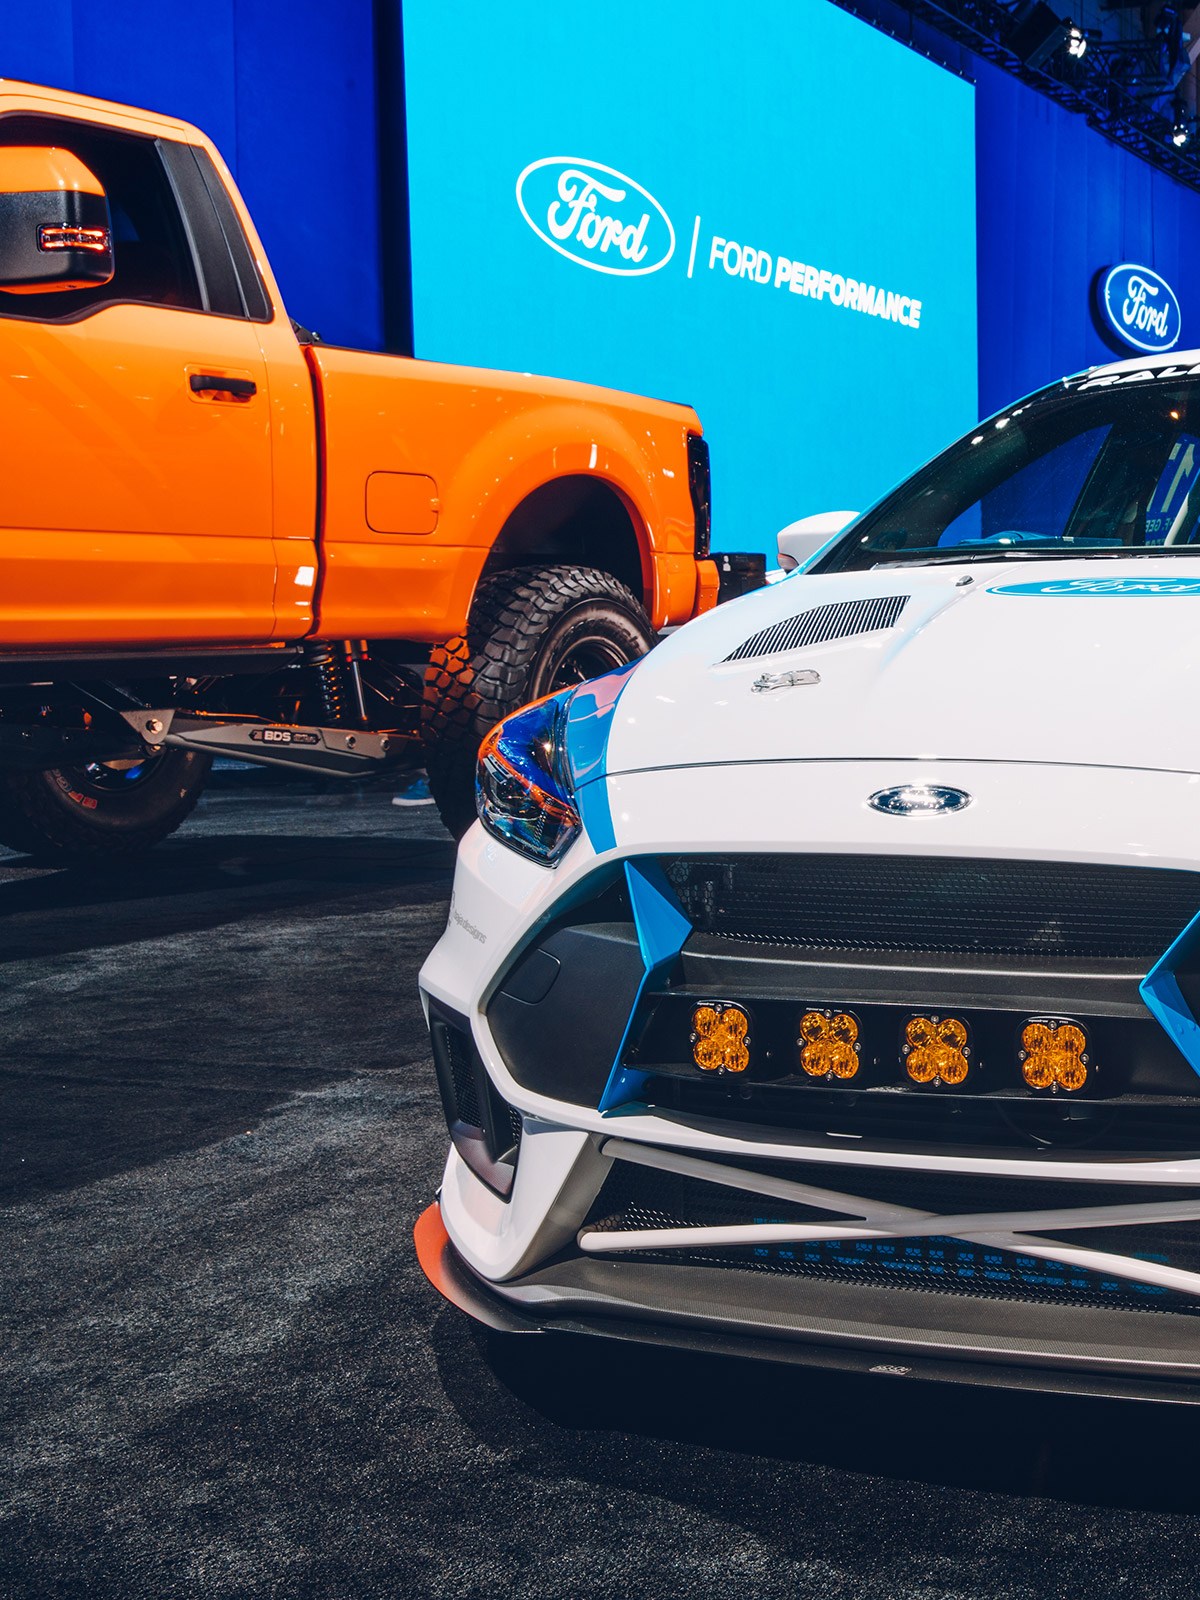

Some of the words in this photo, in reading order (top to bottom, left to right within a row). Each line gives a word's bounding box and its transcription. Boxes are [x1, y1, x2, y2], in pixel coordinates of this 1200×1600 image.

[547, 169, 650, 263] Ford
[708, 235, 773, 284] FORD
[774, 256, 922, 329] PERFORMANCE
[1122, 275, 1169, 338] Ford
[264, 730, 291, 742] BDS
